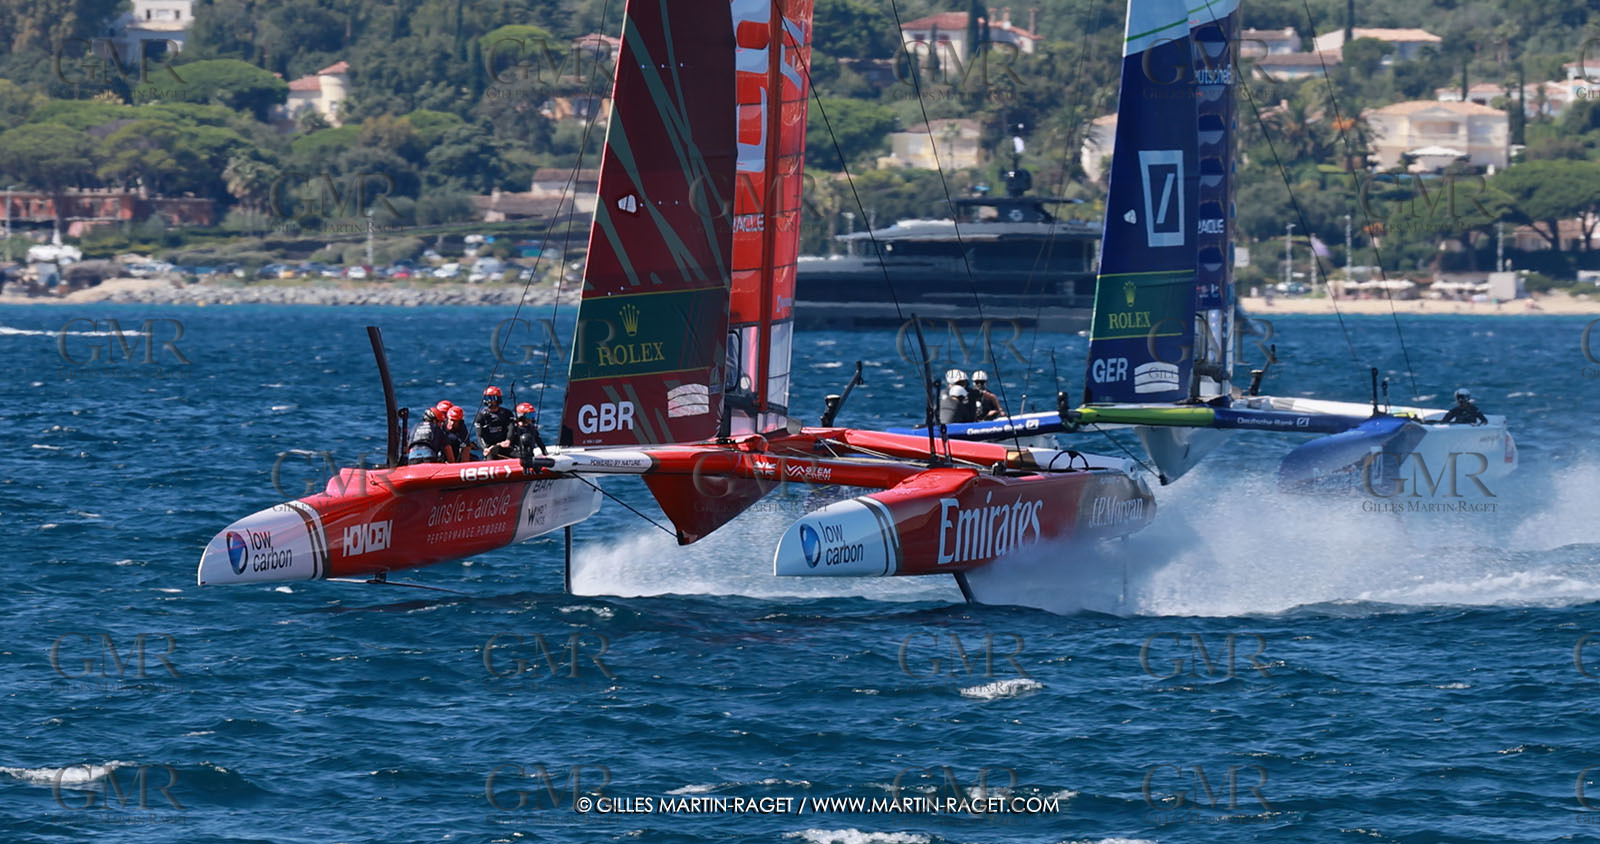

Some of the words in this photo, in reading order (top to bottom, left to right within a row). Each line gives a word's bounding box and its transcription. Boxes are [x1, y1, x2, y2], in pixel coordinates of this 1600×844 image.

[1108, 312, 1152, 329] ROLEX
[597, 342, 664, 366] ROLEX
[1092, 357, 1128, 383] GER
[578, 401, 634, 434] GBR
[246, 528, 272, 550] low
[342, 520, 393, 557] HOWDEN
[427, 530, 474, 545] PERFORMANCE
[477, 522, 507, 536] POWDERS
[818, 521, 844, 543] low
[938, 491, 1043, 564] Emirates
[253, 547, 292, 572] carbon
[826, 541, 863, 565] carbon
